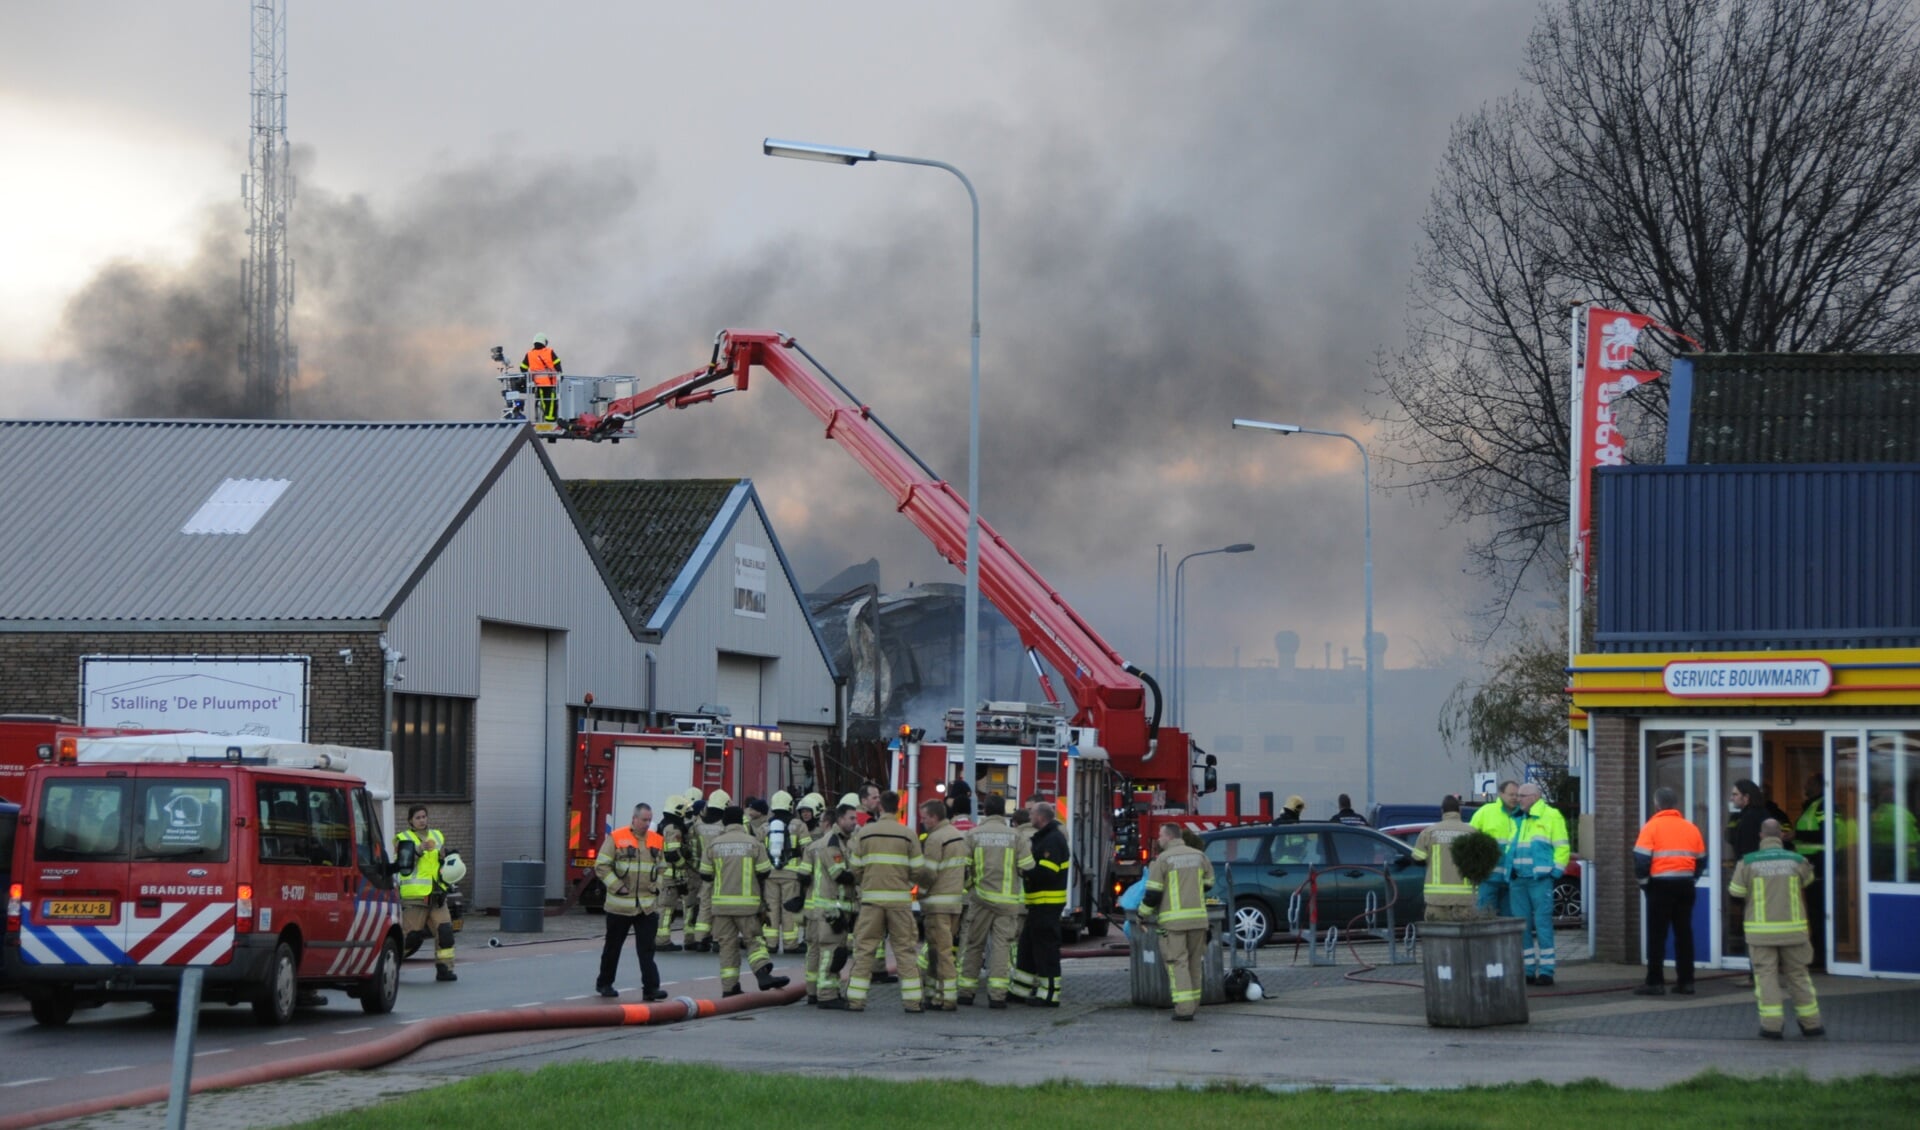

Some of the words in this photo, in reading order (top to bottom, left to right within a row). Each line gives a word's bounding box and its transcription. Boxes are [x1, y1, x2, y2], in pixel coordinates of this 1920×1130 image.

[1672, 669, 1726, 687] SERVICE
[1728, 668, 1821, 687] BOUWMARKT
[111, 696, 168, 712] Stalling
[173, 695, 198, 710] 'De
[202, 695, 282, 712] Pluumpot'
[140, 885, 223, 896] BRANDWEER
[53, 903, 106, 914] 24-KXJ-8
